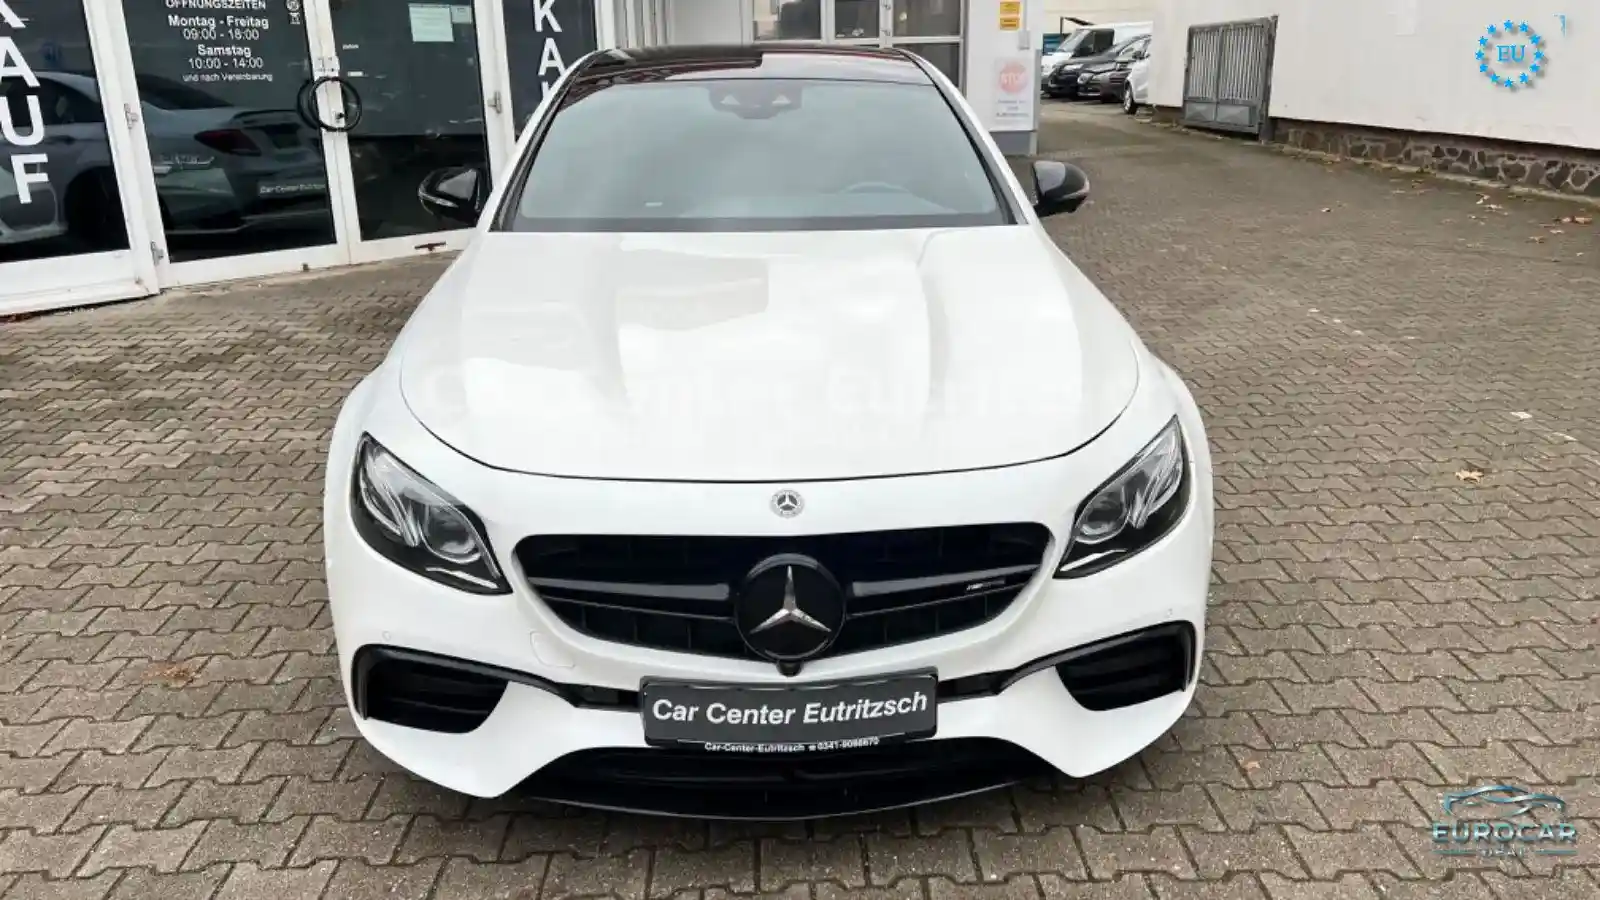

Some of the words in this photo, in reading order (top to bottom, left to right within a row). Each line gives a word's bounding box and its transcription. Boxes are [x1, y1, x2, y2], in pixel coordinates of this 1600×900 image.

[168, 14, 216, 28] Montag
[226, 15, 269, 29] Freitag
[183, 28, 216, 40] 09:00
[228, 28, 259, 40] 18:00
[197, 44, 251, 57] Samstag
[189, 58, 220, 69] 10:00
[233, 58, 263, 69] 14:00
[200, 73, 220, 81] nach
[221, 72, 273, 81] Vereinbarung
[0, 0, 49, 204] AUF
[653, 699, 699, 721] Car
[706, 703, 796, 725] Center
[803, 691, 927, 724] Eutritzsch
